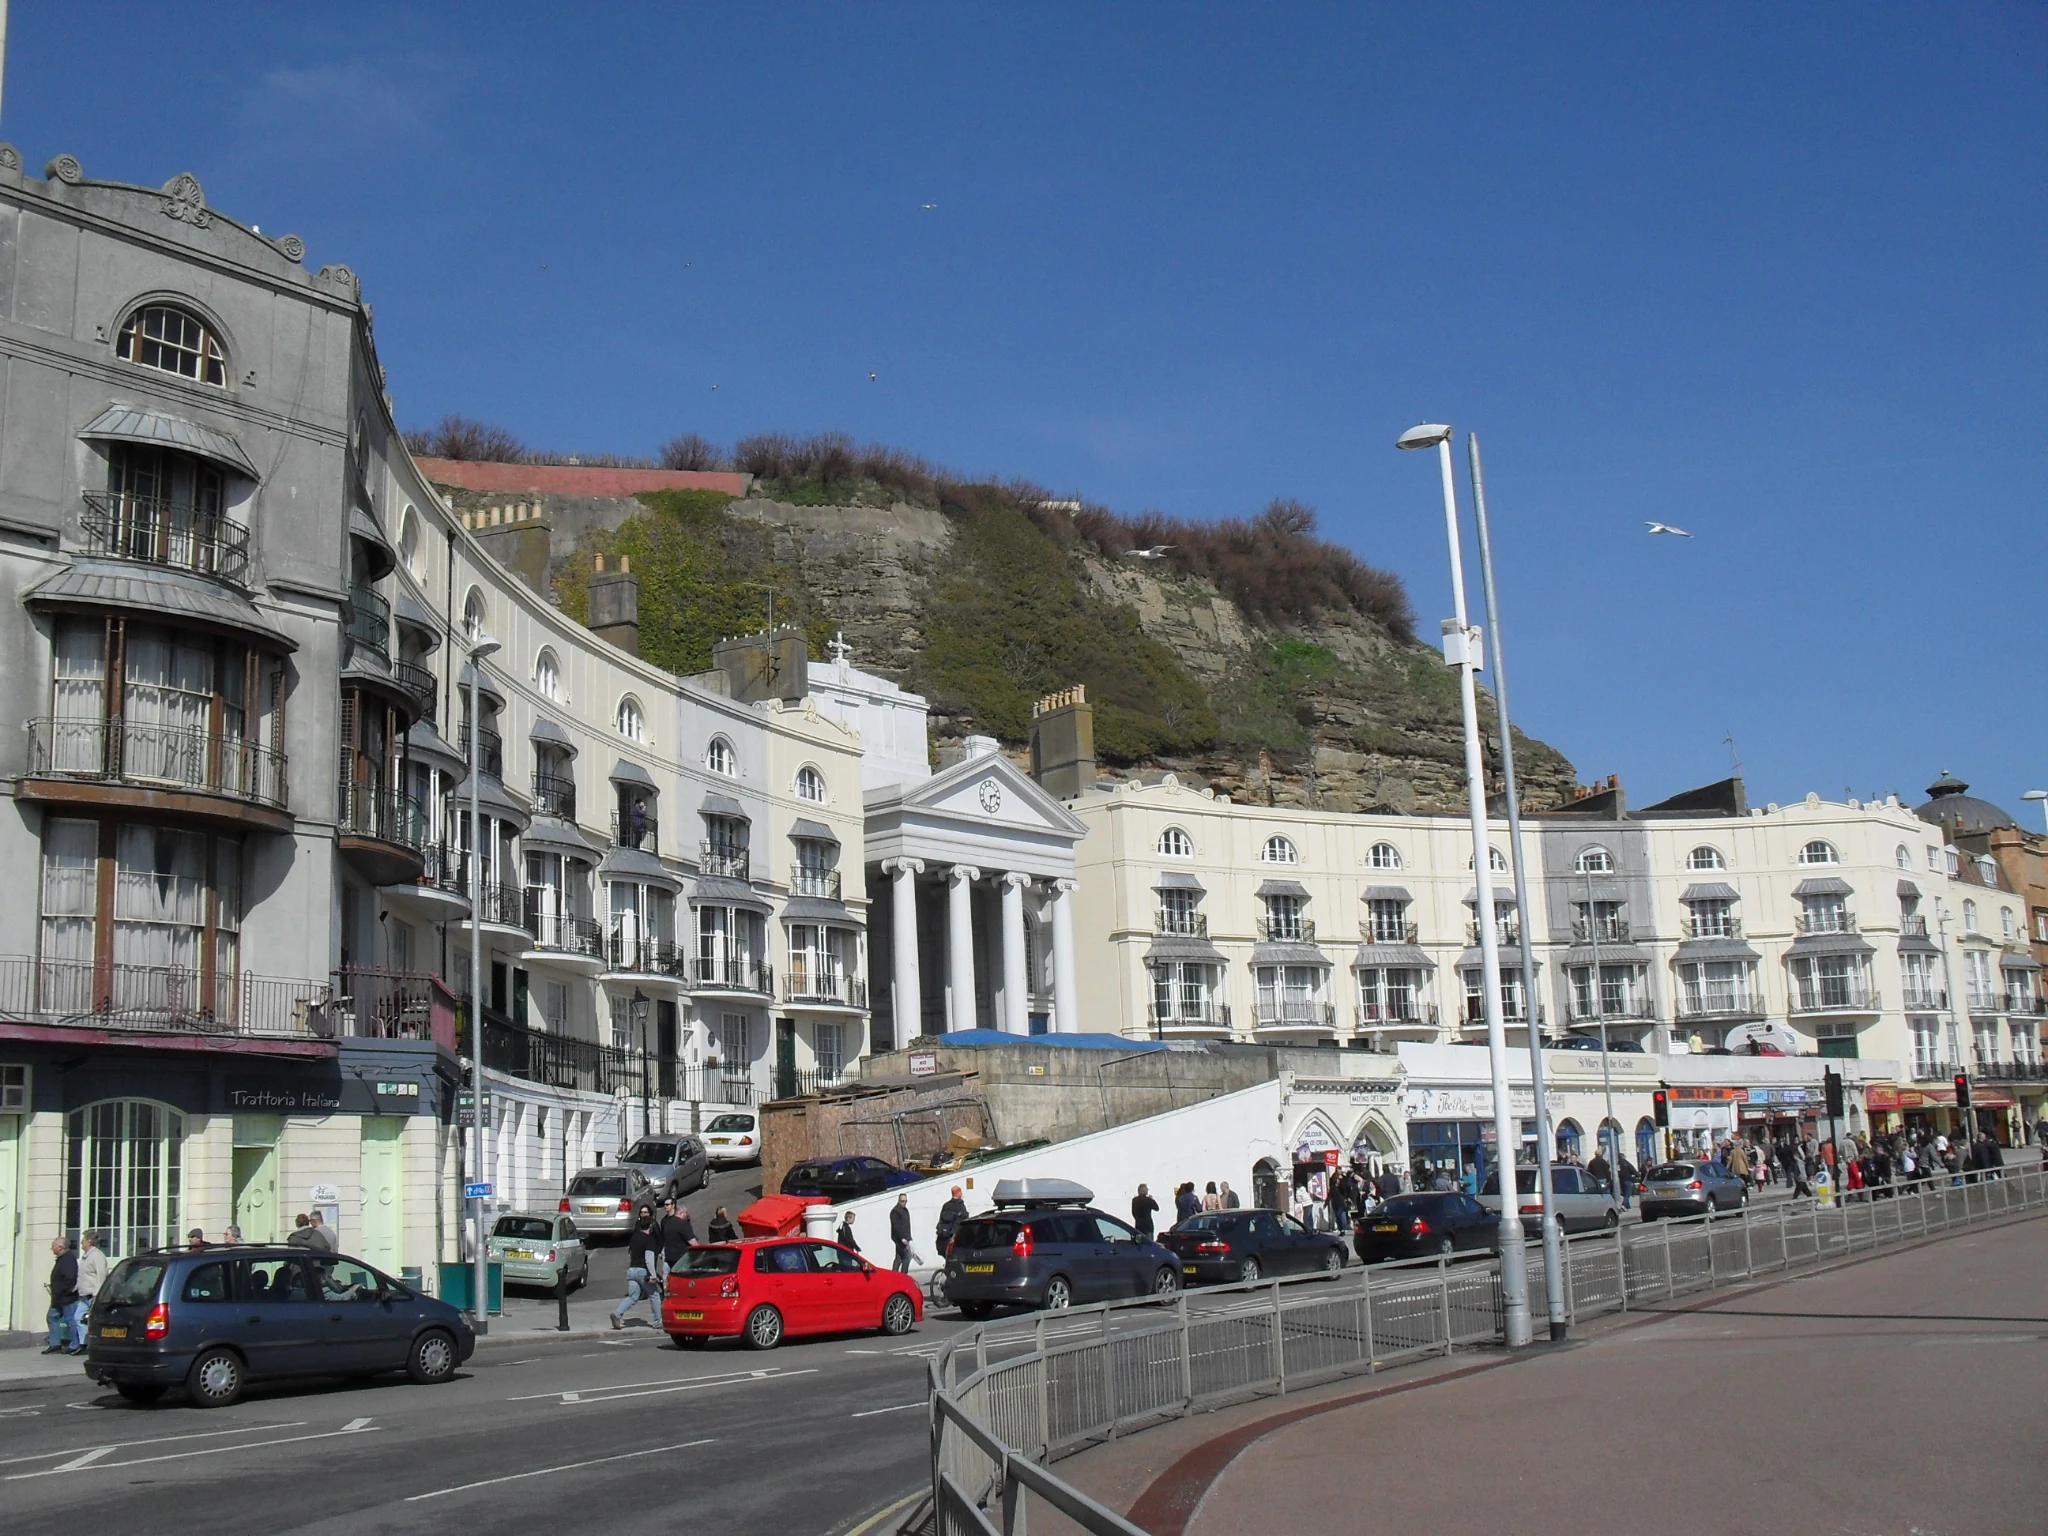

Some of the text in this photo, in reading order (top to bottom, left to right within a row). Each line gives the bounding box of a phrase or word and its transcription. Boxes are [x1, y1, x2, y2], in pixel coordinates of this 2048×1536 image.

[1584, 1058, 1599, 1070] Mary
[1609, 1058, 1617, 1068] the
[1618, 1059, 1633, 1069] Castle
[231, 1090, 339, 1108] Trattoria Italiana
